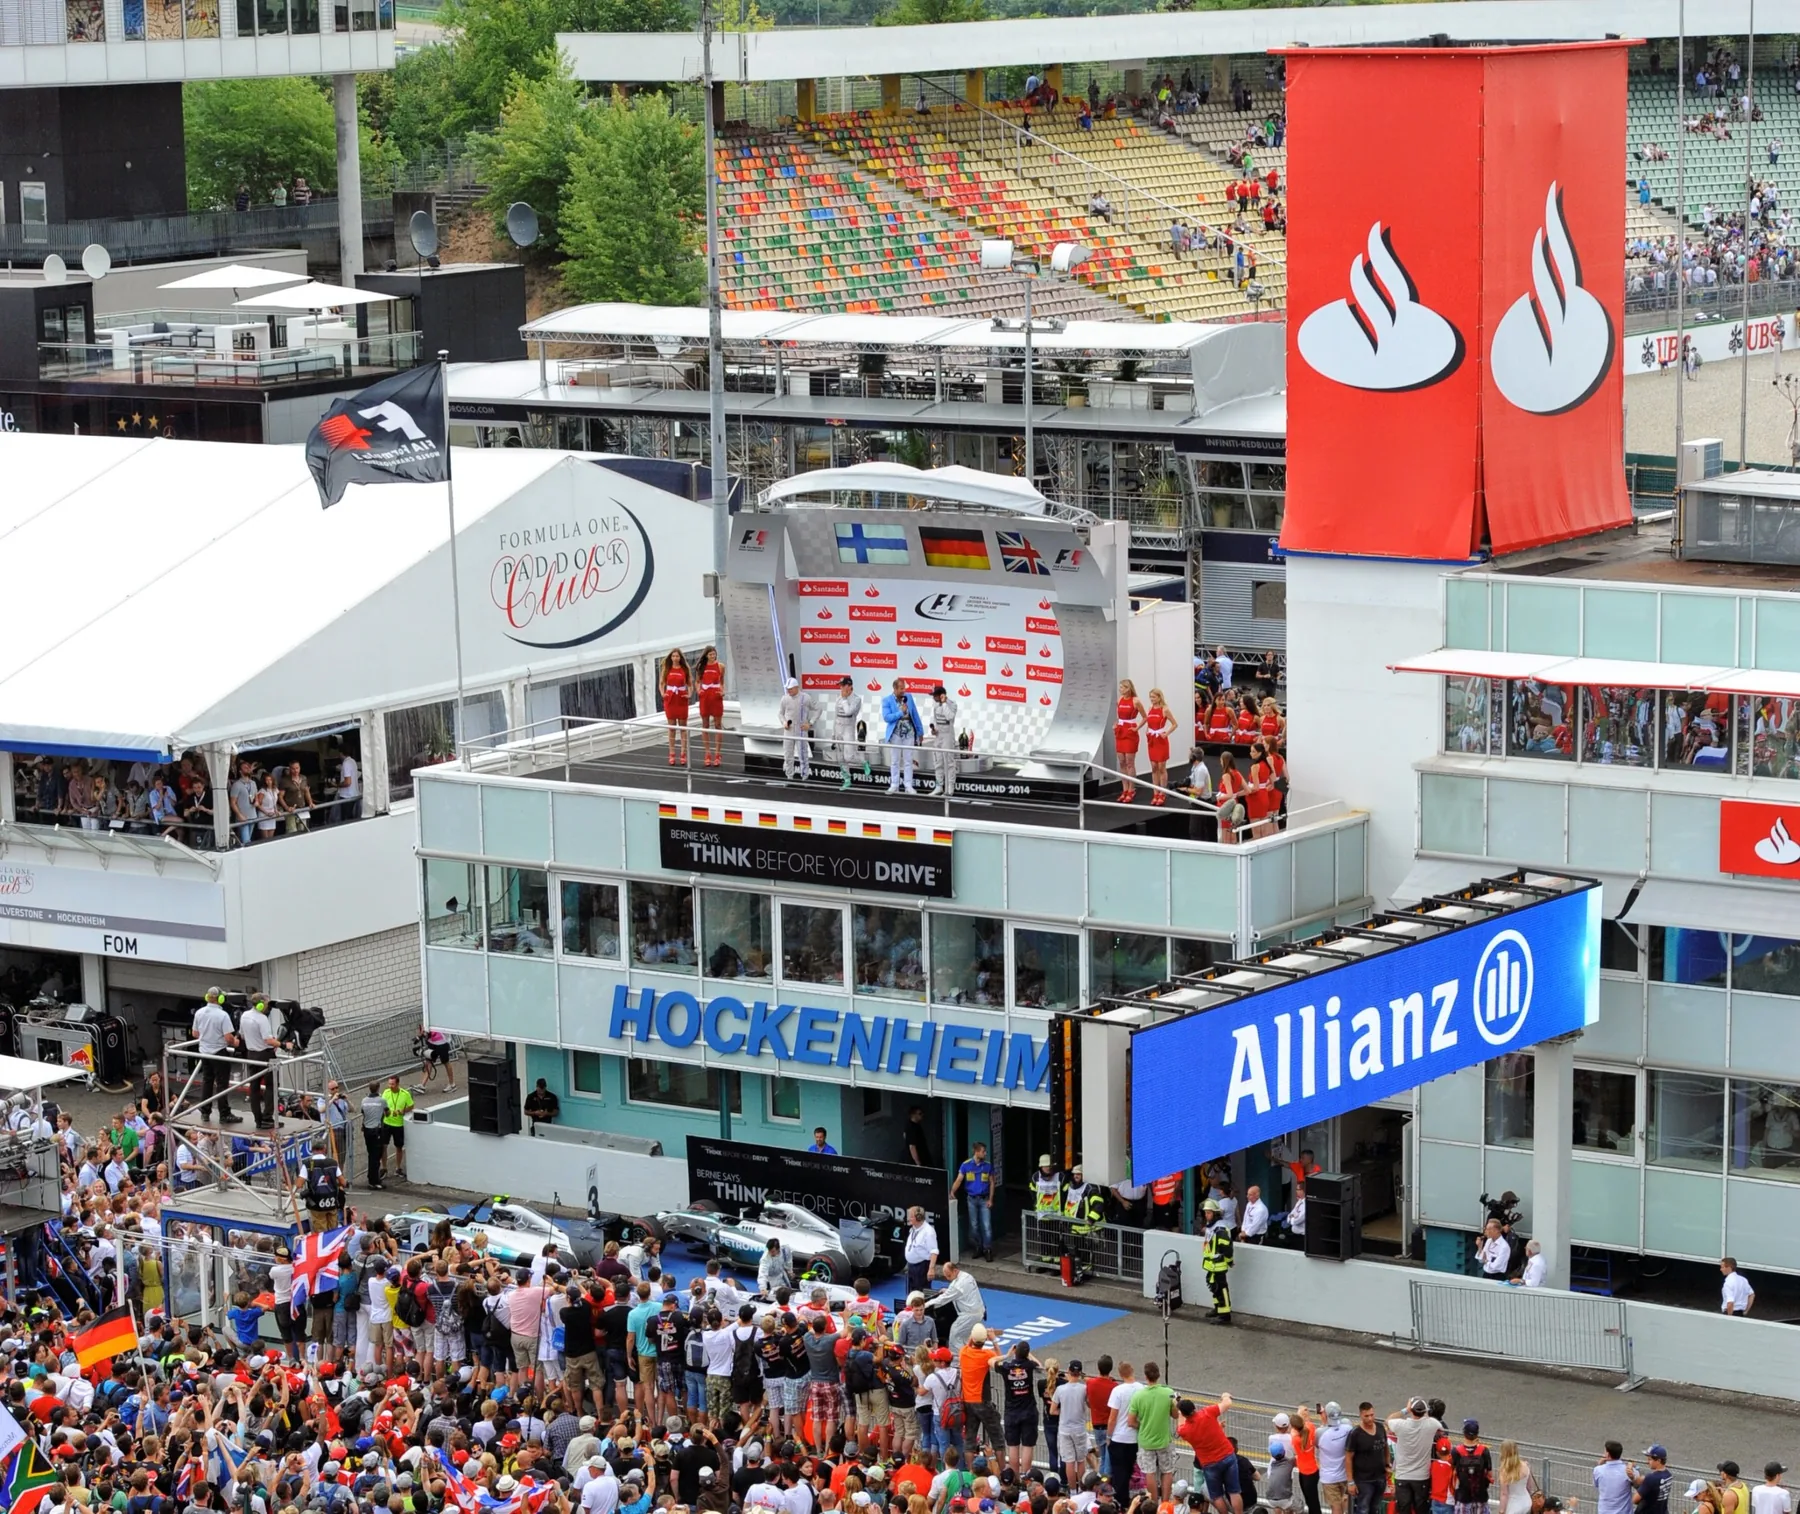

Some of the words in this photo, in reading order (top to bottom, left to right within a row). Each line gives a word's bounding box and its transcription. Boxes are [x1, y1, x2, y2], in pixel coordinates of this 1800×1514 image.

[500, 521, 582, 550] FORMULA
[503, 543, 624, 584] PADDOCK
[491, 538, 630, 628] Club
[812, 585, 846, 593] Santander
[862, 610, 894, 618] Santander
[813, 632, 847, 640] Santander
[909, 635, 940, 644] Santander
[996, 642, 1025, 651] Santander
[863, 656, 895, 665] Santander
[953, 662, 984, 671] Santander
[1036, 669, 1063, 679] Santander
[815, 678, 839, 686] Santan
[910, 682, 936, 690] Santand
[997, 689, 1025, 698] Santander
[820, 768, 844, 780] GROSS
[853, 774, 873, 783] PREIS
[923, 780, 937, 789] VO
[954, 782, 1005, 793] UTSCHLAND
[1008, 785, 1030, 794] 2014
[670, 829, 699, 841] BERNIE
[700, 832, 720, 844] SAYS:
[756, 850, 825, 876] BEFORE
[829, 857, 870, 880] YOU
[0, 906, 43, 919] ILVERSTONE
[57, 912, 106, 926] HOCKENHEIM
[103, 935, 138, 955] FOM
[608, 984, 1050, 1093] HOCKENHEIM
[1222, 978, 1460, 1126] Allianz
[696, 1168, 722, 1180] BERNIE
[722, 1172, 741, 1184] SAYS:
[319, 1197, 335, 1208] 662
[588, 1186, 600, 1218] 3
[621, 1227, 630, 1239] 6
[892, 1226, 901, 1239] 6
[720, 1237, 766, 1252] PETRONA
